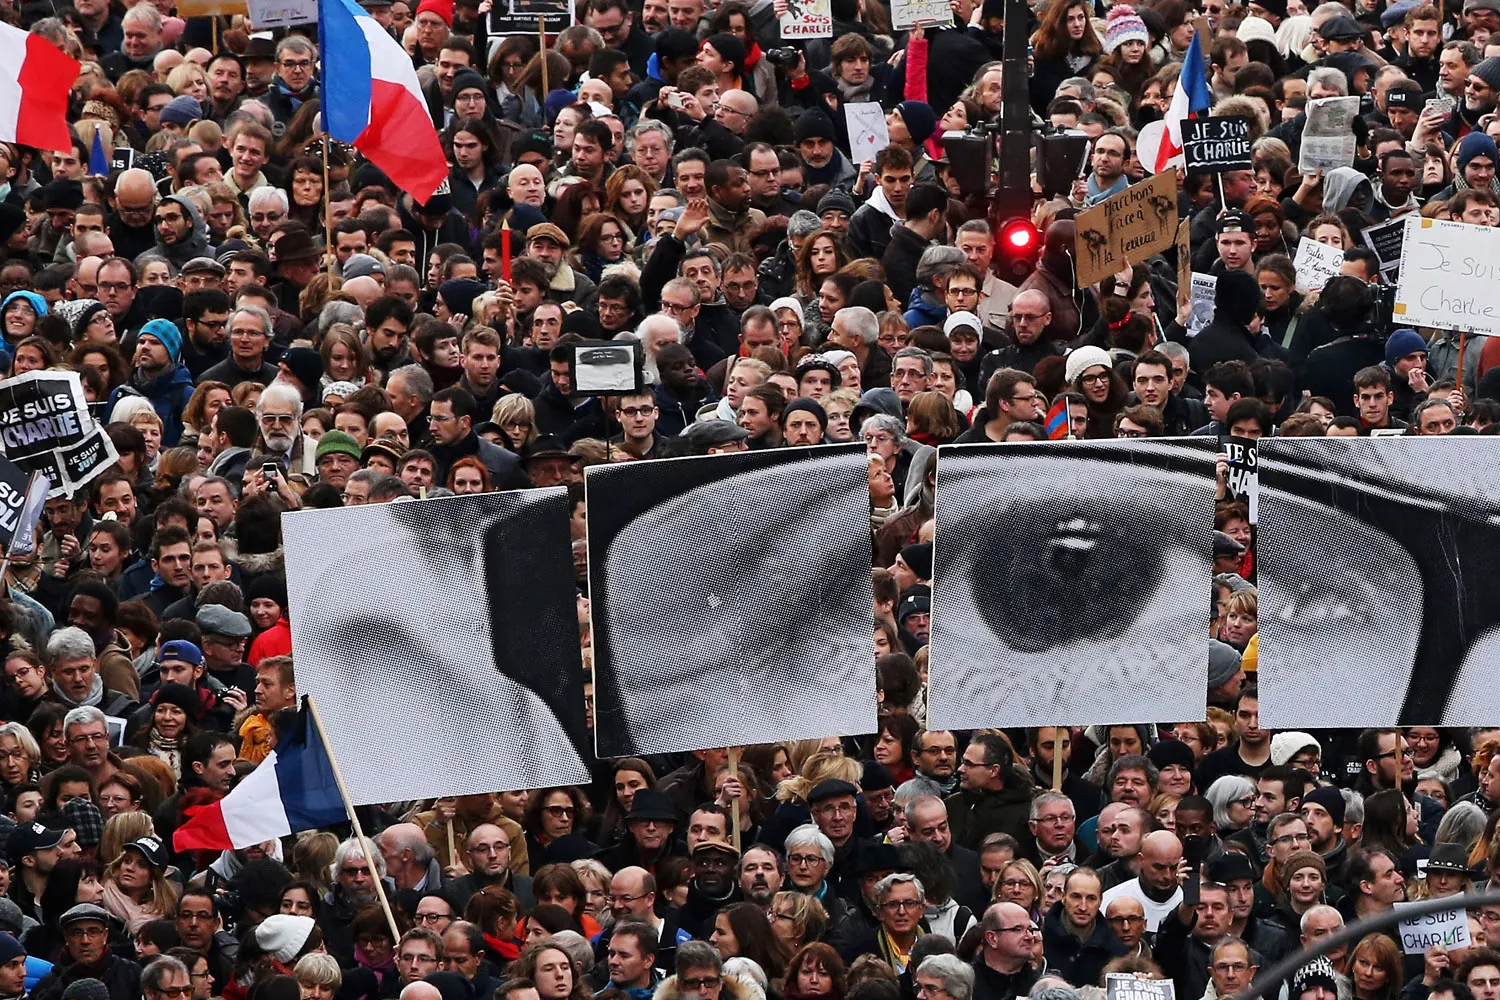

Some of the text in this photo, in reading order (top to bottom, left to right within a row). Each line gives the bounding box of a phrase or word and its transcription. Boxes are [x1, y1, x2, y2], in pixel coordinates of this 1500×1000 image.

[1191, 123, 1211, 140] JE
[112, 159, 125, 168] IS
[22, 394, 72, 421] SUIS
[5, 411, 81, 449] CHARLIE
[68, 442, 102, 467] JE SUIS
[1224, 442, 1244, 460] JE
[1403, 926, 1466, 949] CHARLIE
[1114, 980, 1164, 995] JE SUIS
